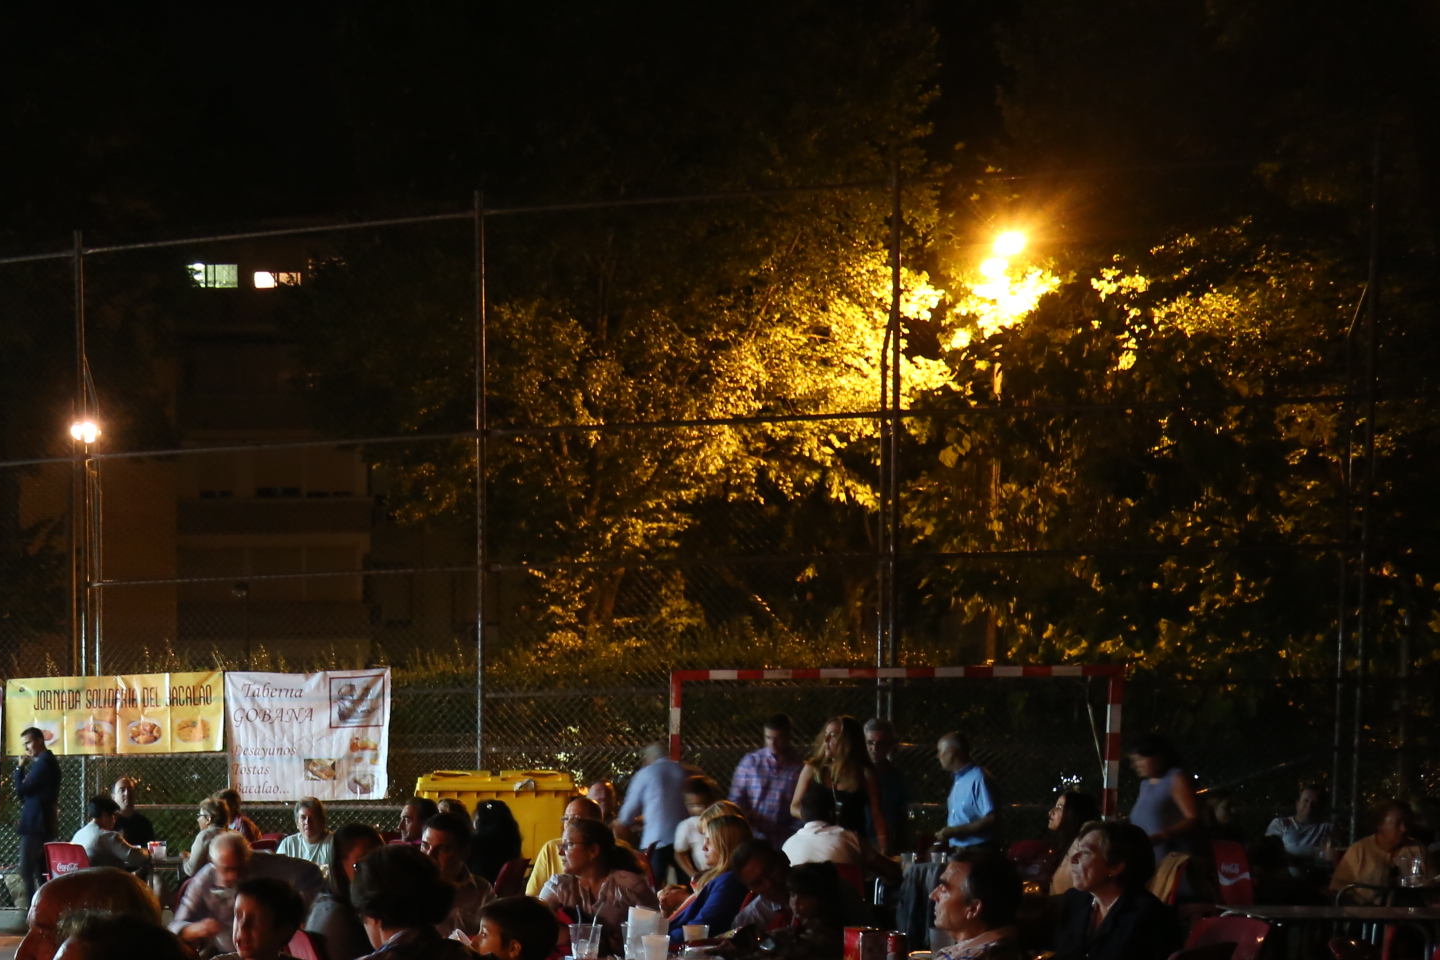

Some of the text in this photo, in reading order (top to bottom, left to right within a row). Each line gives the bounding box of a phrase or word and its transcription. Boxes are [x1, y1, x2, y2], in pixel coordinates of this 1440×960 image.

[33, 688, 81, 711] JORNADA
[85, 685, 138, 710] SOLIDARIA
[142, 686, 161, 709] DEL
[241, 681, 304, 699] Taberna
[233, 707, 314, 728] GOBANA
[232, 745, 297, 760] Desayunos
[232, 763, 270, 775] Tostas
